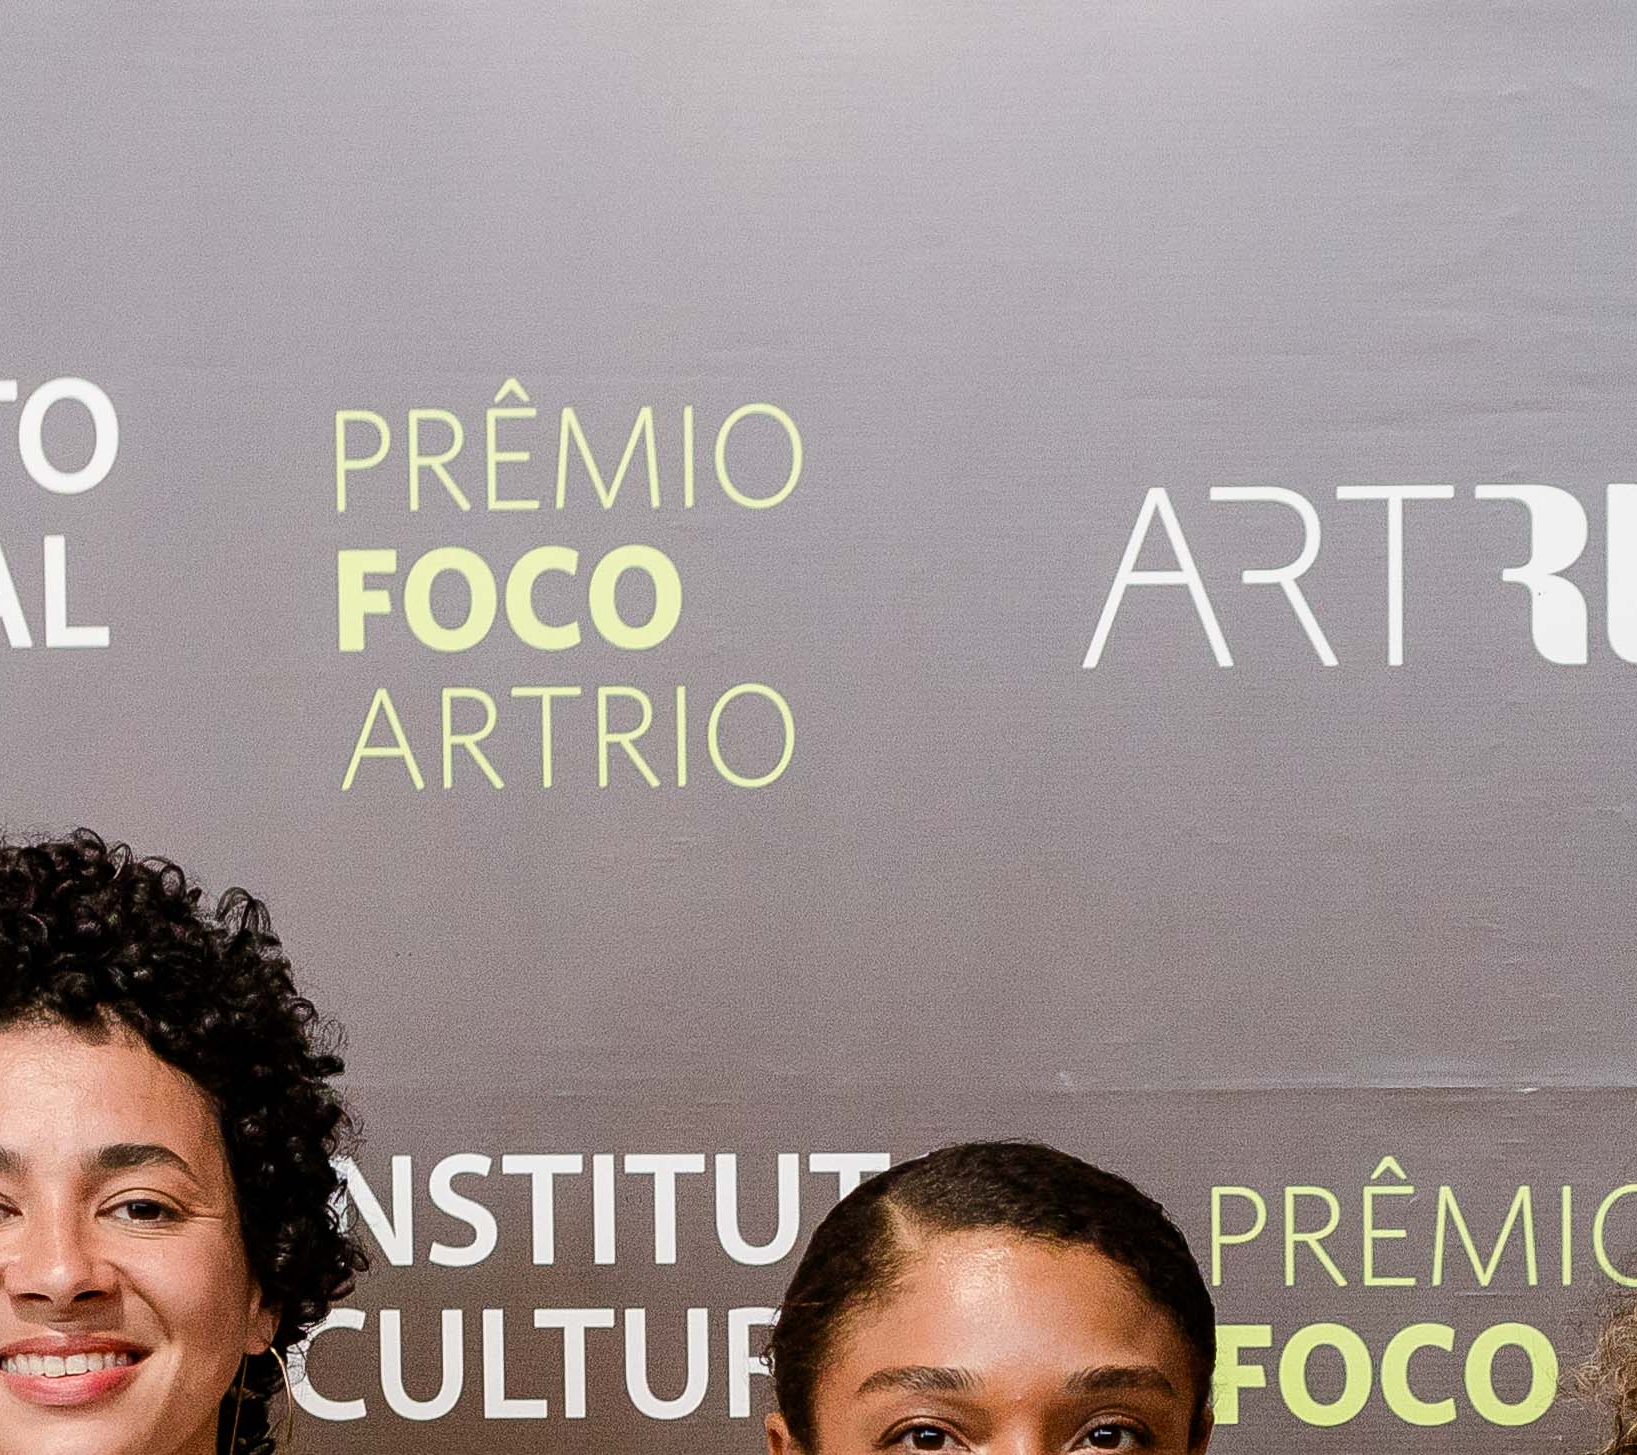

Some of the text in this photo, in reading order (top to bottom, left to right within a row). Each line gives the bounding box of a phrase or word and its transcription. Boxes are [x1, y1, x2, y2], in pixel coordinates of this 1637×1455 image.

[334, 377, 803, 511] PRÊMIO
[337, 544, 682, 652] FOCO
[342, 682, 796, 790] ARTRIO
[1211, 1323, 1556, 1426] FOCO
